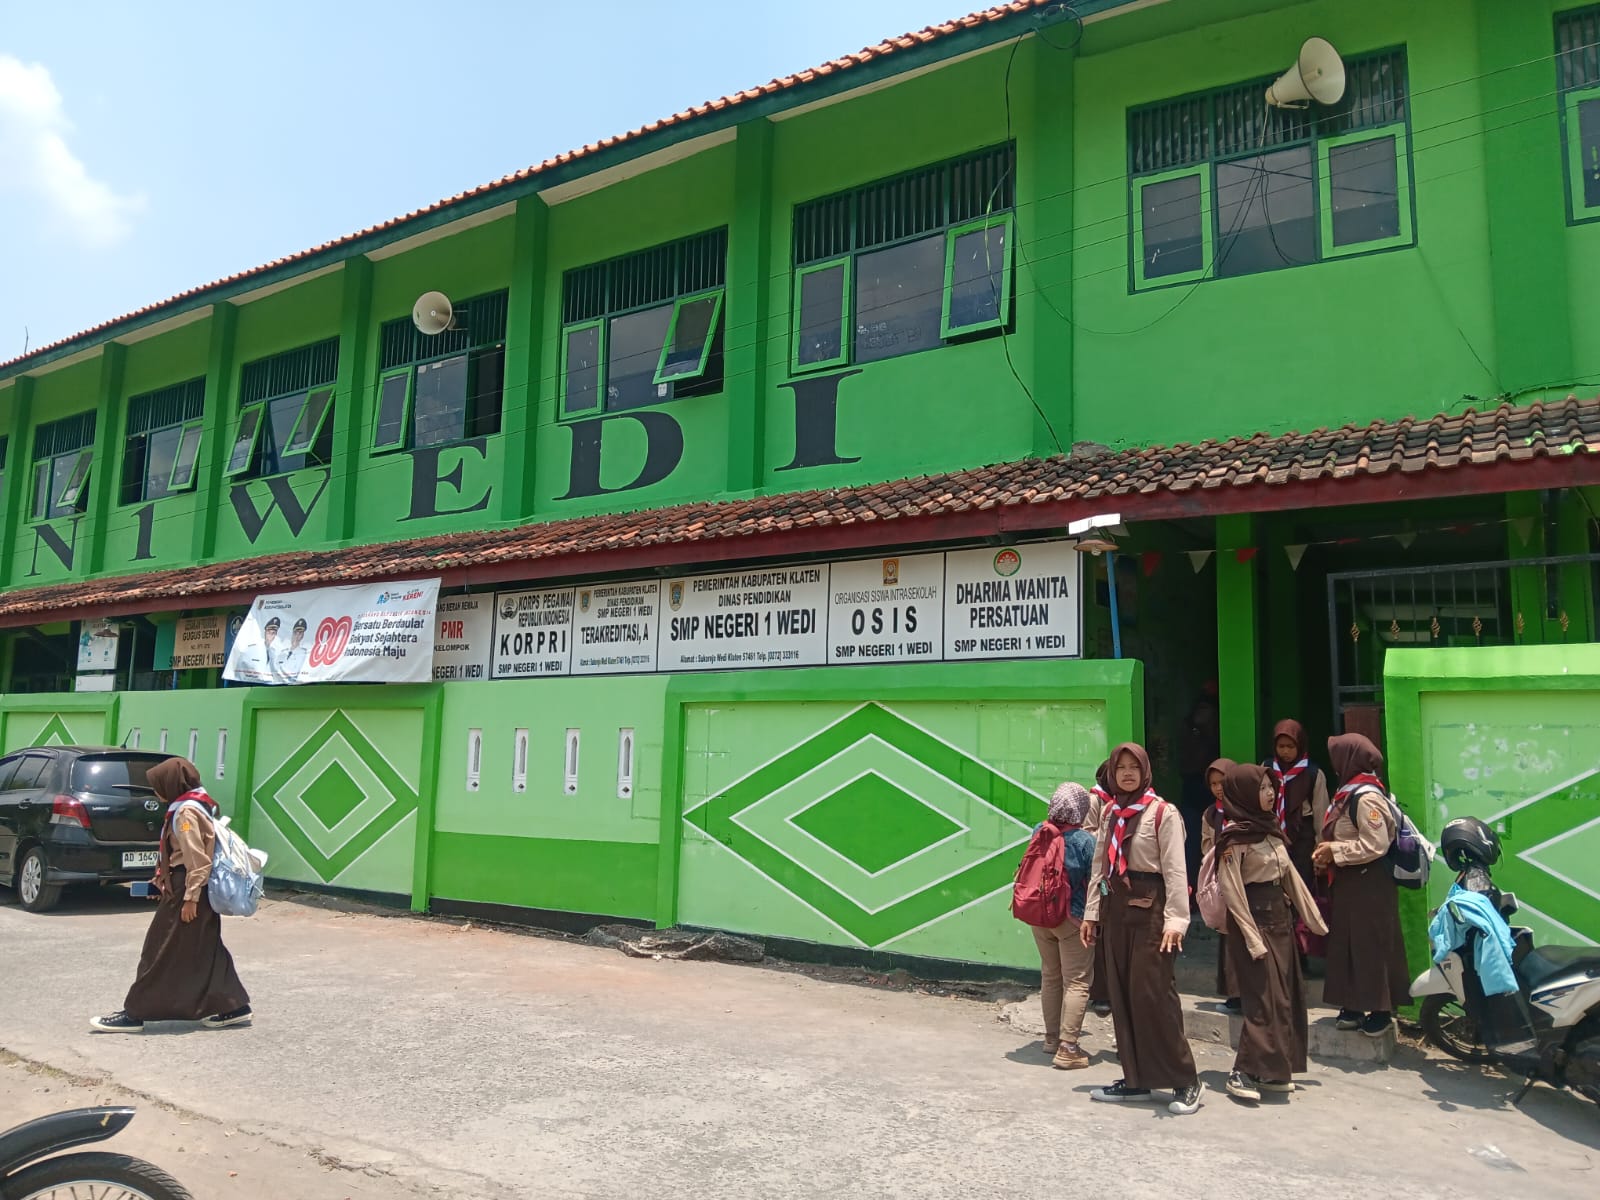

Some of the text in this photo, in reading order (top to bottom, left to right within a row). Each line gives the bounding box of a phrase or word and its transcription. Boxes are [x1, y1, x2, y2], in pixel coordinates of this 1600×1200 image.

[24, 516, 84, 578] N
[129, 503, 157, 562] 1
[693, 569, 820, 592] PEMERINTAH KABUPATEN KLATEN
[719, 590, 791, 607] DINAS PENDIDIKAN
[835, 590, 870, 604] ORGANISASI
[871, 590, 888, 602] SISWA
[956, 576, 1068, 604] DHARMA WANITA
[519, 592, 573, 610] KORPS PEGAWAI
[543, 610, 570, 625] INDONESIA
[598, 606, 652, 618] SMP NEGERI 1 WEDI
[852, 606, 917, 635] OSIS
[970, 604, 1048, 628] PERSATUAN
[353, 618, 424, 631] Bersatu Berdaulat
[441, 621, 464, 639] PMR
[581, 622, 649, 644] TERAKREDITASI, A
[670, 609, 816, 641] SMP NEGERI 1 WEDI
[183, 629, 219, 641] GUGUS DEPAN
[309, 616, 352, 668] 80
[375, 633, 417, 645] Sejahtera
[500, 630, 566, 656] KORPRI
[954, 635, 1065, 652] SMP NEGERI 1 WEDI
[383, 645, 406, 659] Maju
[434, 644, 470, 652] KELOMPOK
[836, 641, 932, 657] SMP NEGERI 1 WEDI
[169, 656, 181, 667] SMP
[183, 654, 205, 667] NEGERI
[206, 654, 210, 665] 1
[498, 661, 562, 674] SMP NEGERI 1 WEDI
[460, 665, 463, 678] 1
[465, 664, 483, 678] WEDI
